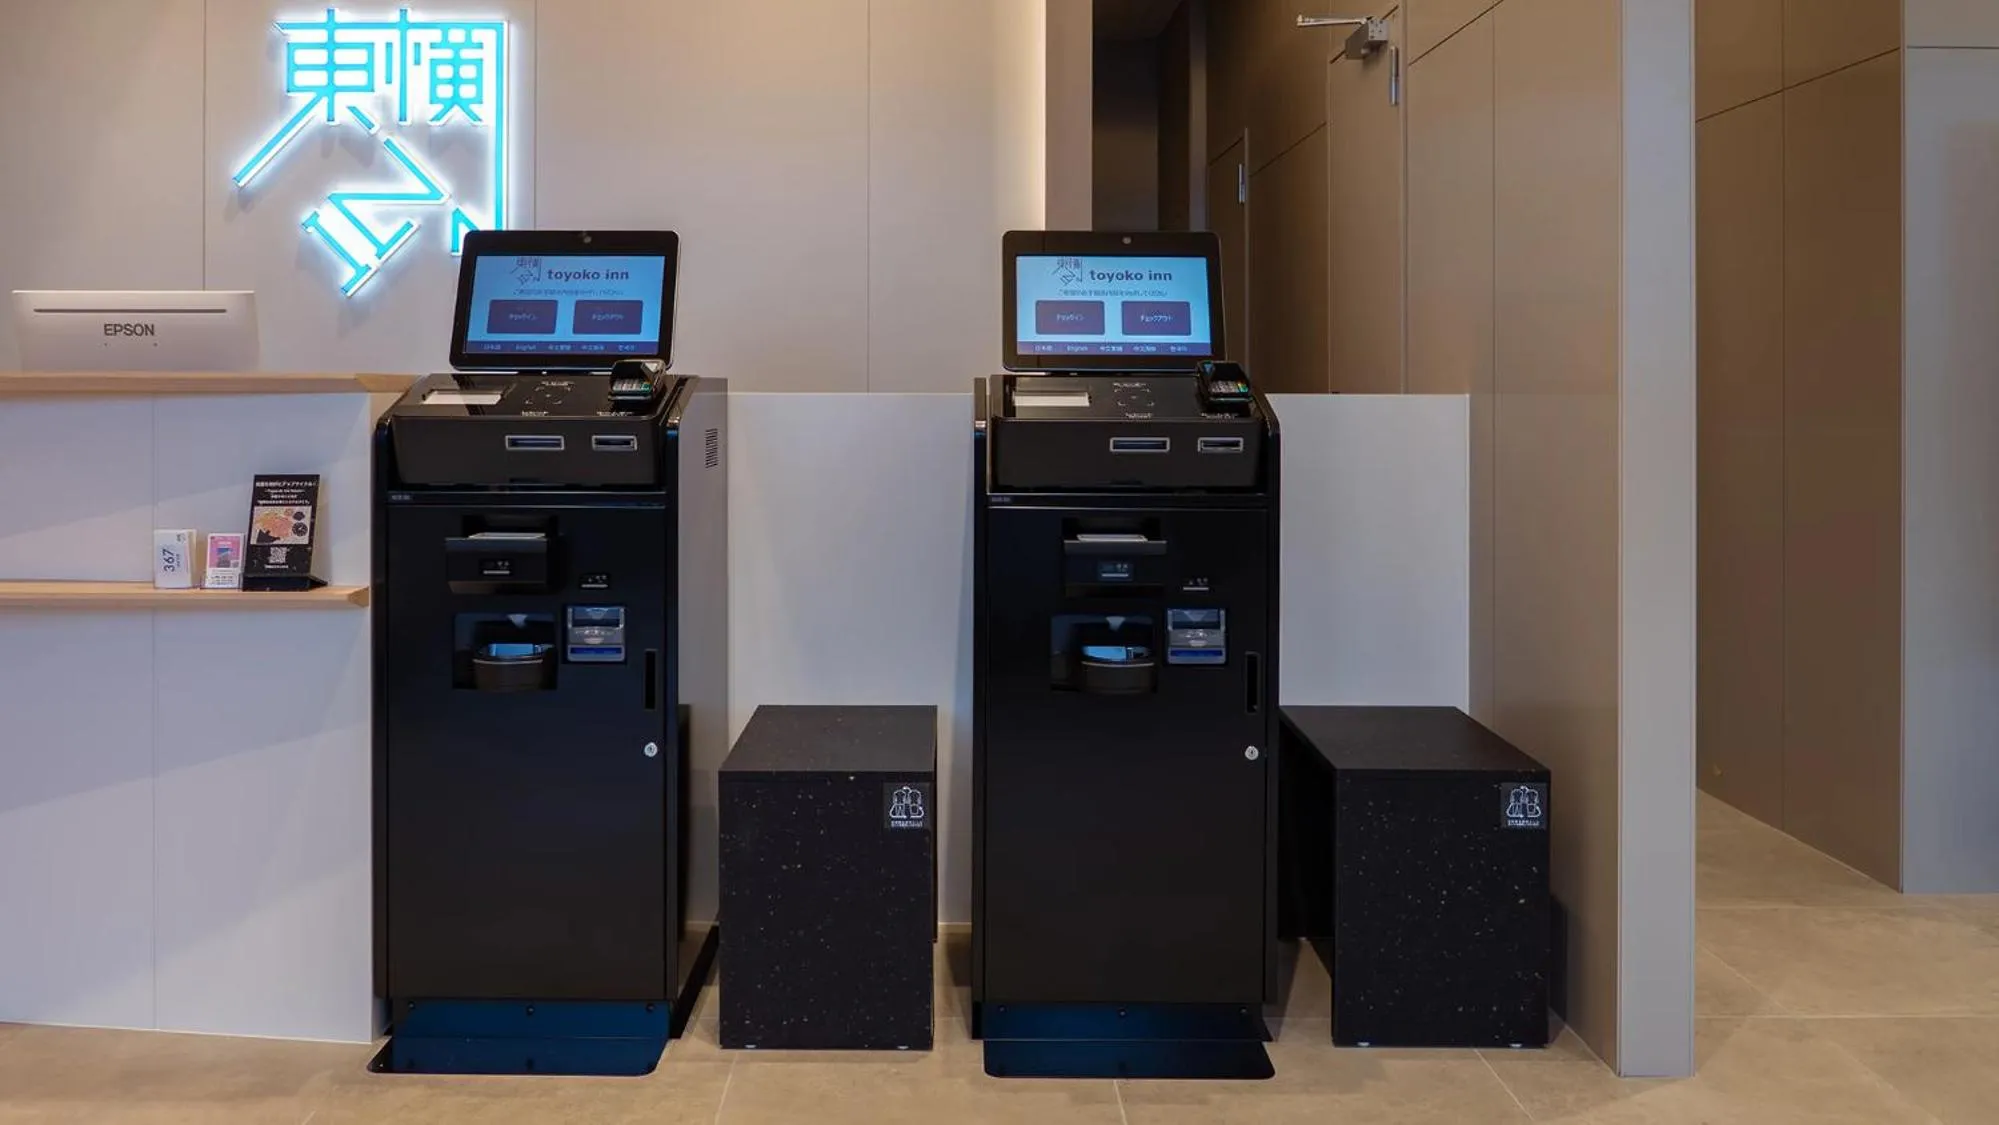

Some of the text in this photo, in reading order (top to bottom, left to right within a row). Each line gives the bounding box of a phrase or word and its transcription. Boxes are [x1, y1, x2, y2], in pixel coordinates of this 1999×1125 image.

[547, 269, 601, 282] toyoko
[605, 269, 630, 280] inn
[1090, 270, 1143, 283] toyoko
[1148, 270, 1172, 281] inn
[103, 323, 155, 337] EPSON
[162, 548, 176, 572] 367
